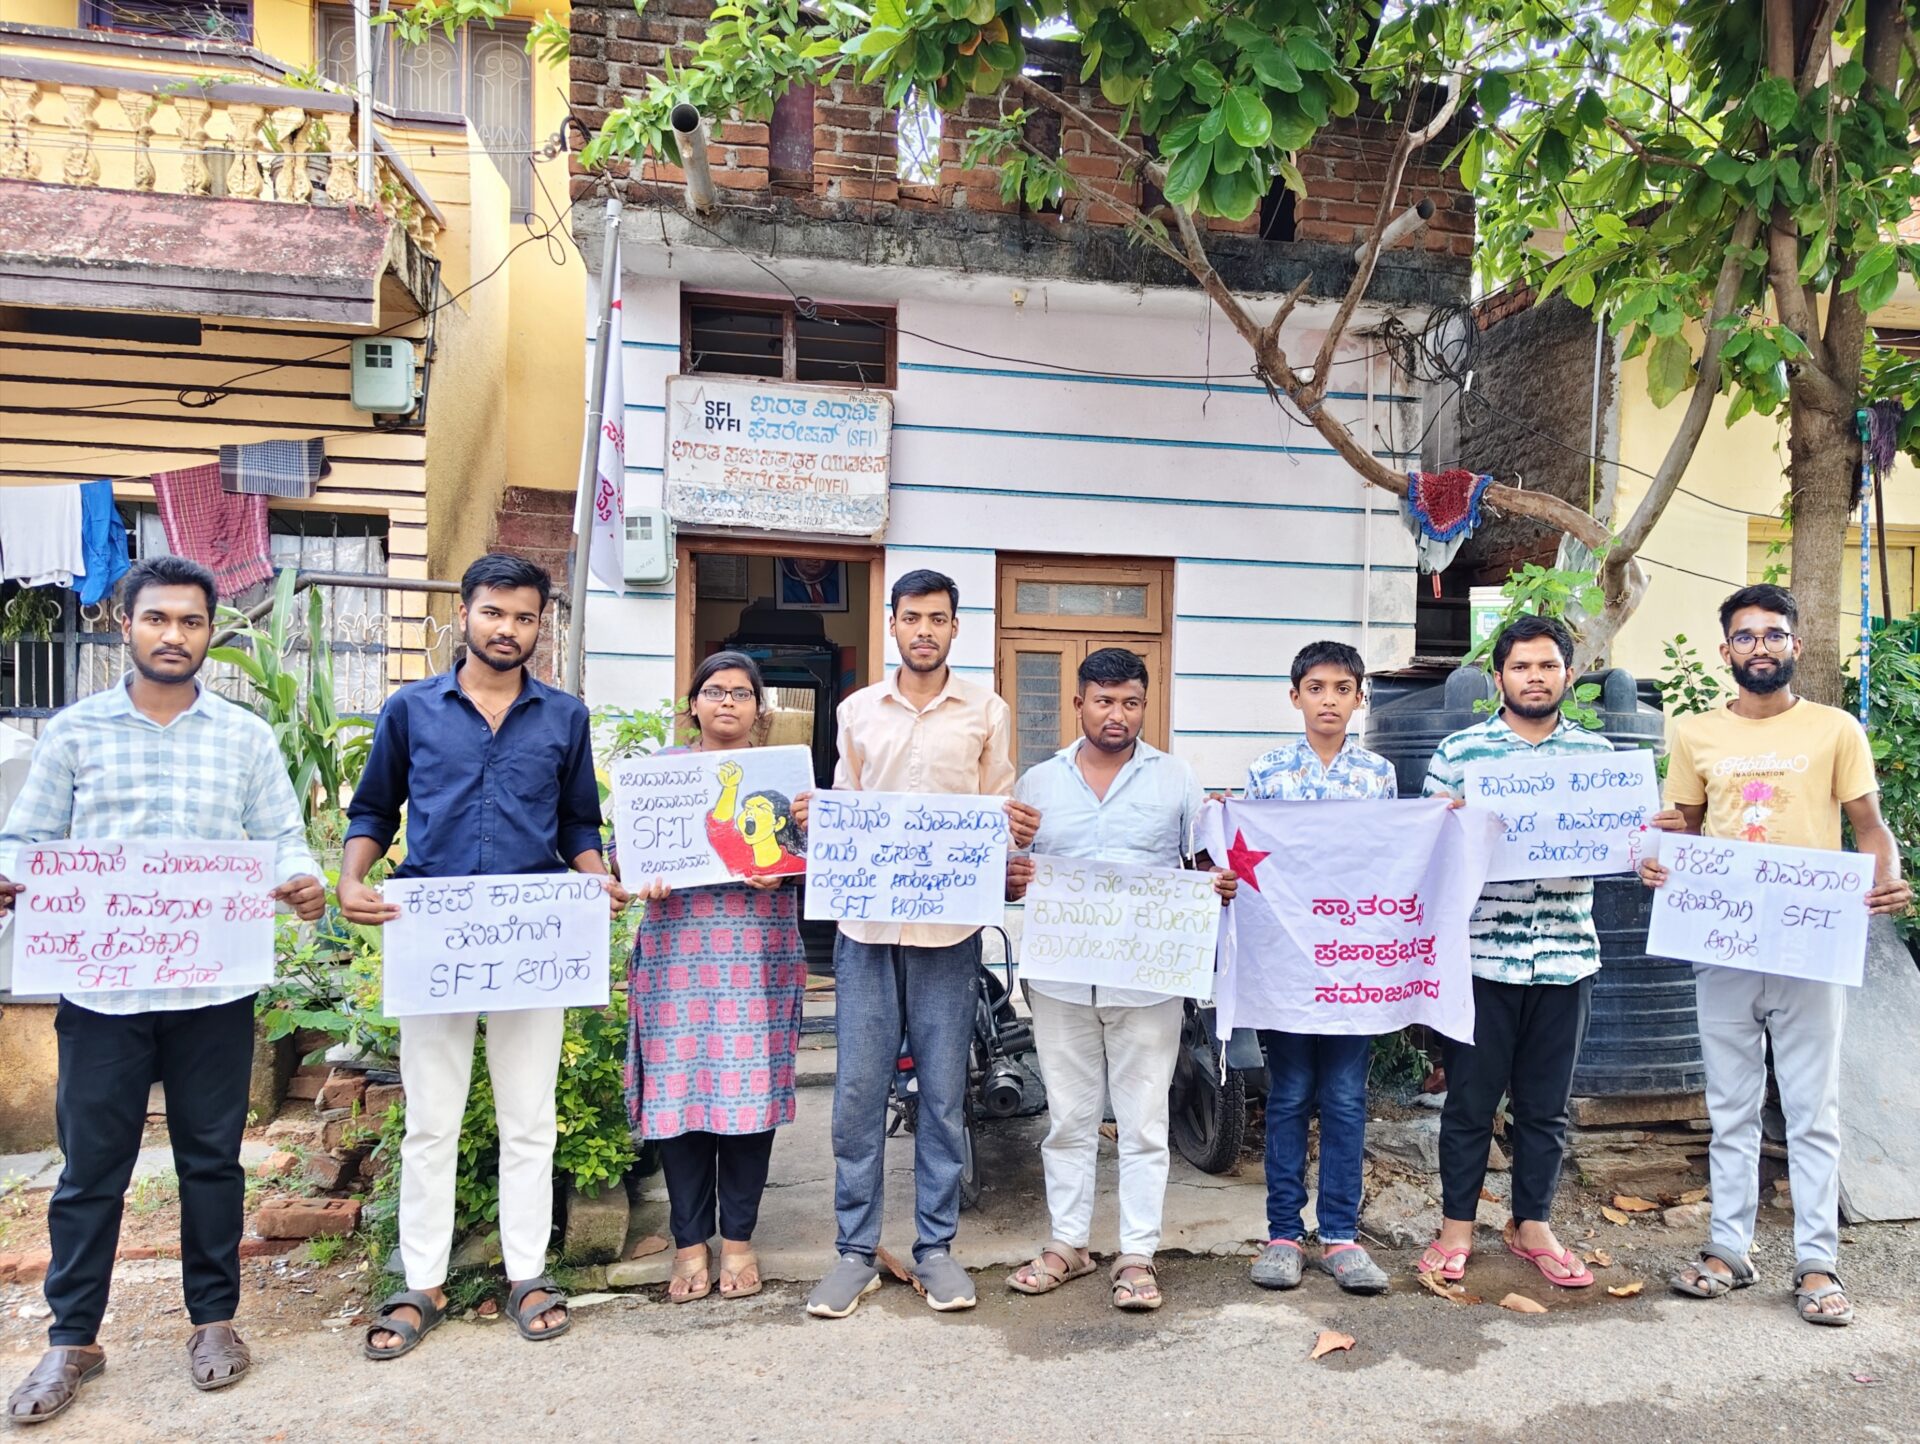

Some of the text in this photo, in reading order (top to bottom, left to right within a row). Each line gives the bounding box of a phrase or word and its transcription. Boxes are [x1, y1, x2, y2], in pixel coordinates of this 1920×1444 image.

[705, 400, 731, 416] SFI
[751, 395, 807, 416] ಭಾರತ
[705, 416, 740, 432] DYFI
[848, 427, 878, 448] (SFI)
[672, 440, 720, 464] ಭಾರತ
[814, 476, 849, 495] (DYFI)
[1478, 768, 1643, 797] ಕಾನೂನು ಕಾಲೇಜು
[633, 813, 694, 849] SFI
[818, 800, 891, 833] ಕಾನೂನು
[1499, 812, 1537, 841] ಟ್ಟಡ
[26, 844, 127, 877] ಕಾನೂನು
[1754, 859, 1860, 892] ಕಾಮಗಾರಿ
[104, 889, 212, 923] ಕಾಮಗಾರಿ
[403, 877, 602, 915] ಕಳಪೆ ಕಾಮಗಾರಿ
[830, 894, 877, 919] SFI
[1781, 905, 1841, 929] SFI
[444, 914, 562, 950] ತನಿಖೆಗಾಗಿ
[1158, 940, 1214, 972] SFI
[1314, 935, 1437, 966] ಪ್ರಜಾಪ್ರಭತ್ವ
[77, 964, 137, 988] SFI
[429, 951, 591, 997] SFI ಆಗ್ರಹ
[1314, 979, 1440, 1004] ಸಮಾಜವಾದ
